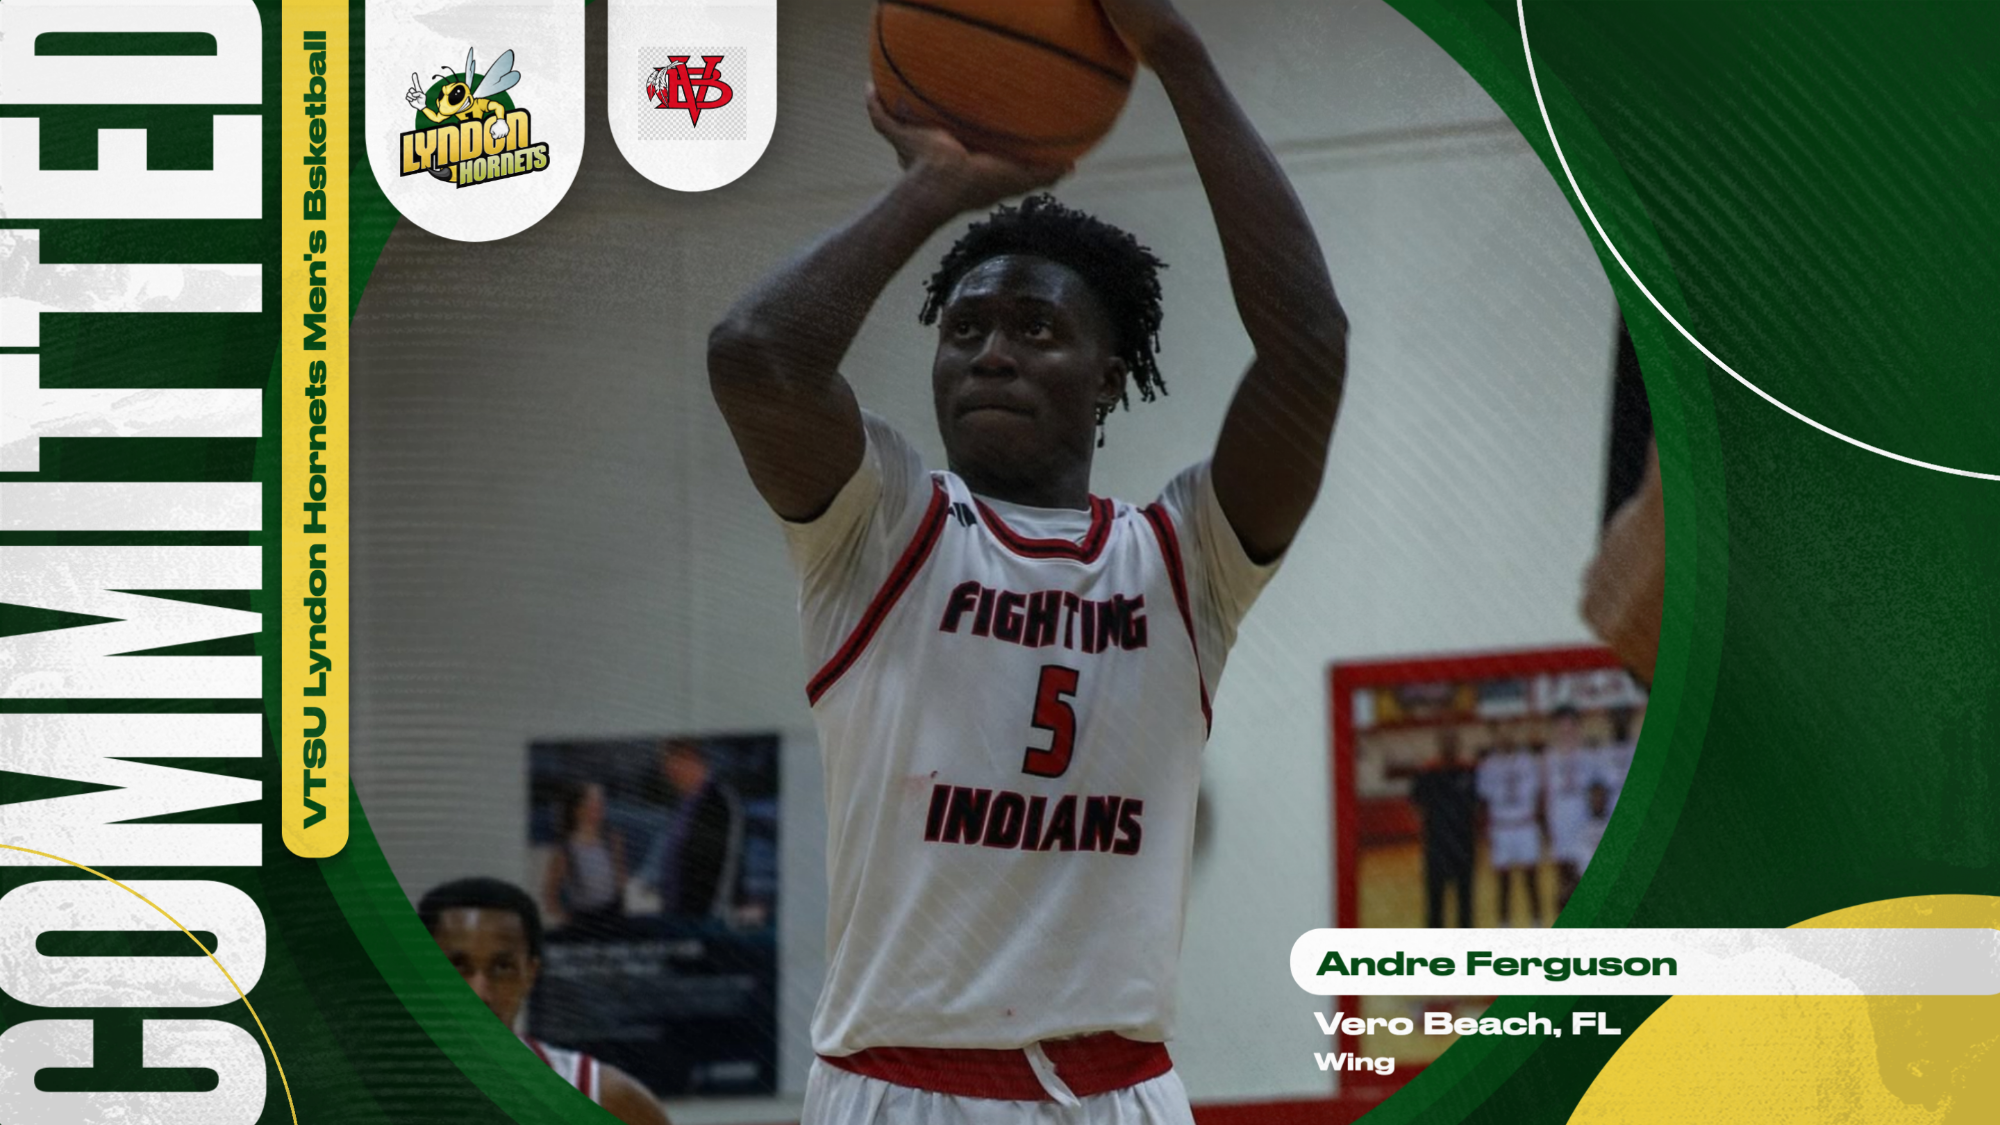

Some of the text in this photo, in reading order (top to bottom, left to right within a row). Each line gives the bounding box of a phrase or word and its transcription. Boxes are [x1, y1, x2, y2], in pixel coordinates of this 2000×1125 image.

[939, 580, 1149, 654] FIGHTING
[1021, 664, 1080, 779] 5
[924, 784, 1144, 856] INDIANS
